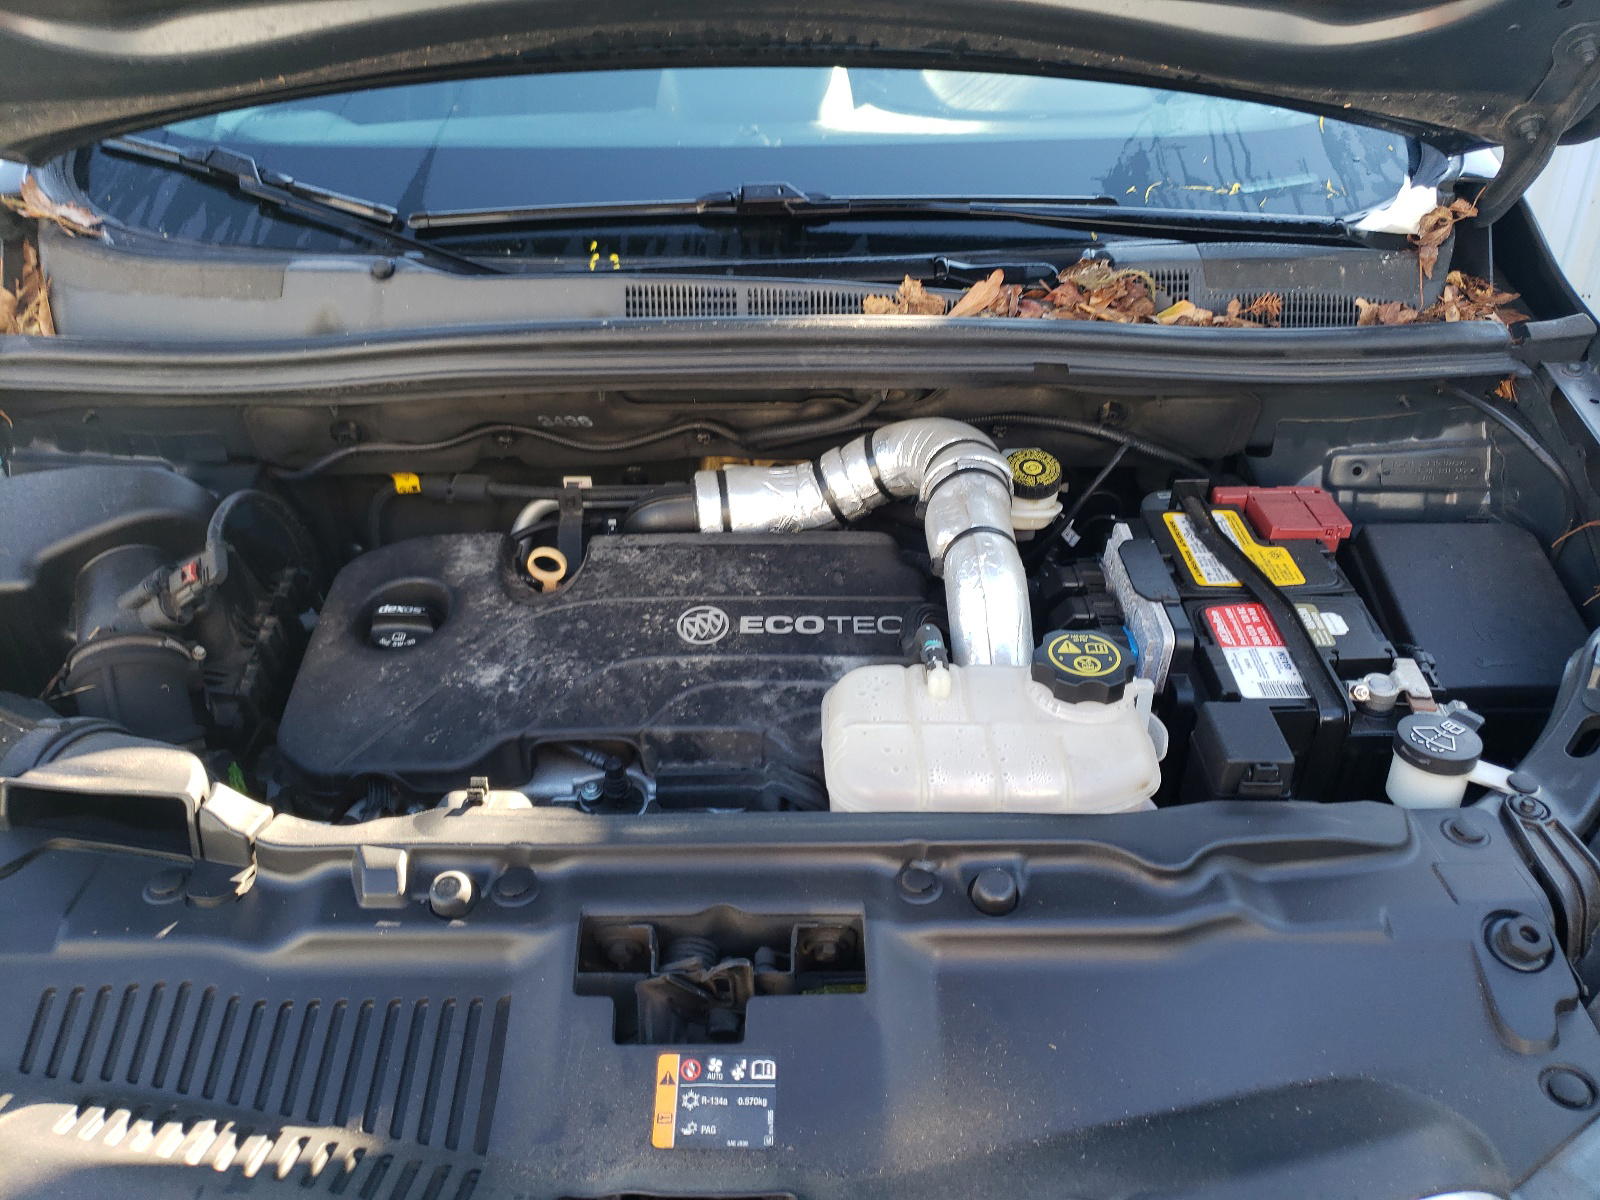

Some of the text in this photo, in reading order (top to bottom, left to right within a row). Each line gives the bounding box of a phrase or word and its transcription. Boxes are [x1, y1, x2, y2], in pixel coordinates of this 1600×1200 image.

[739, 615, 903, 634] ECOTEC
[707, 1072, 723, 1081] AUTO
[701, 1096, 728, 1106] R-134a
[701, 1125, 717, 1135] PAG
